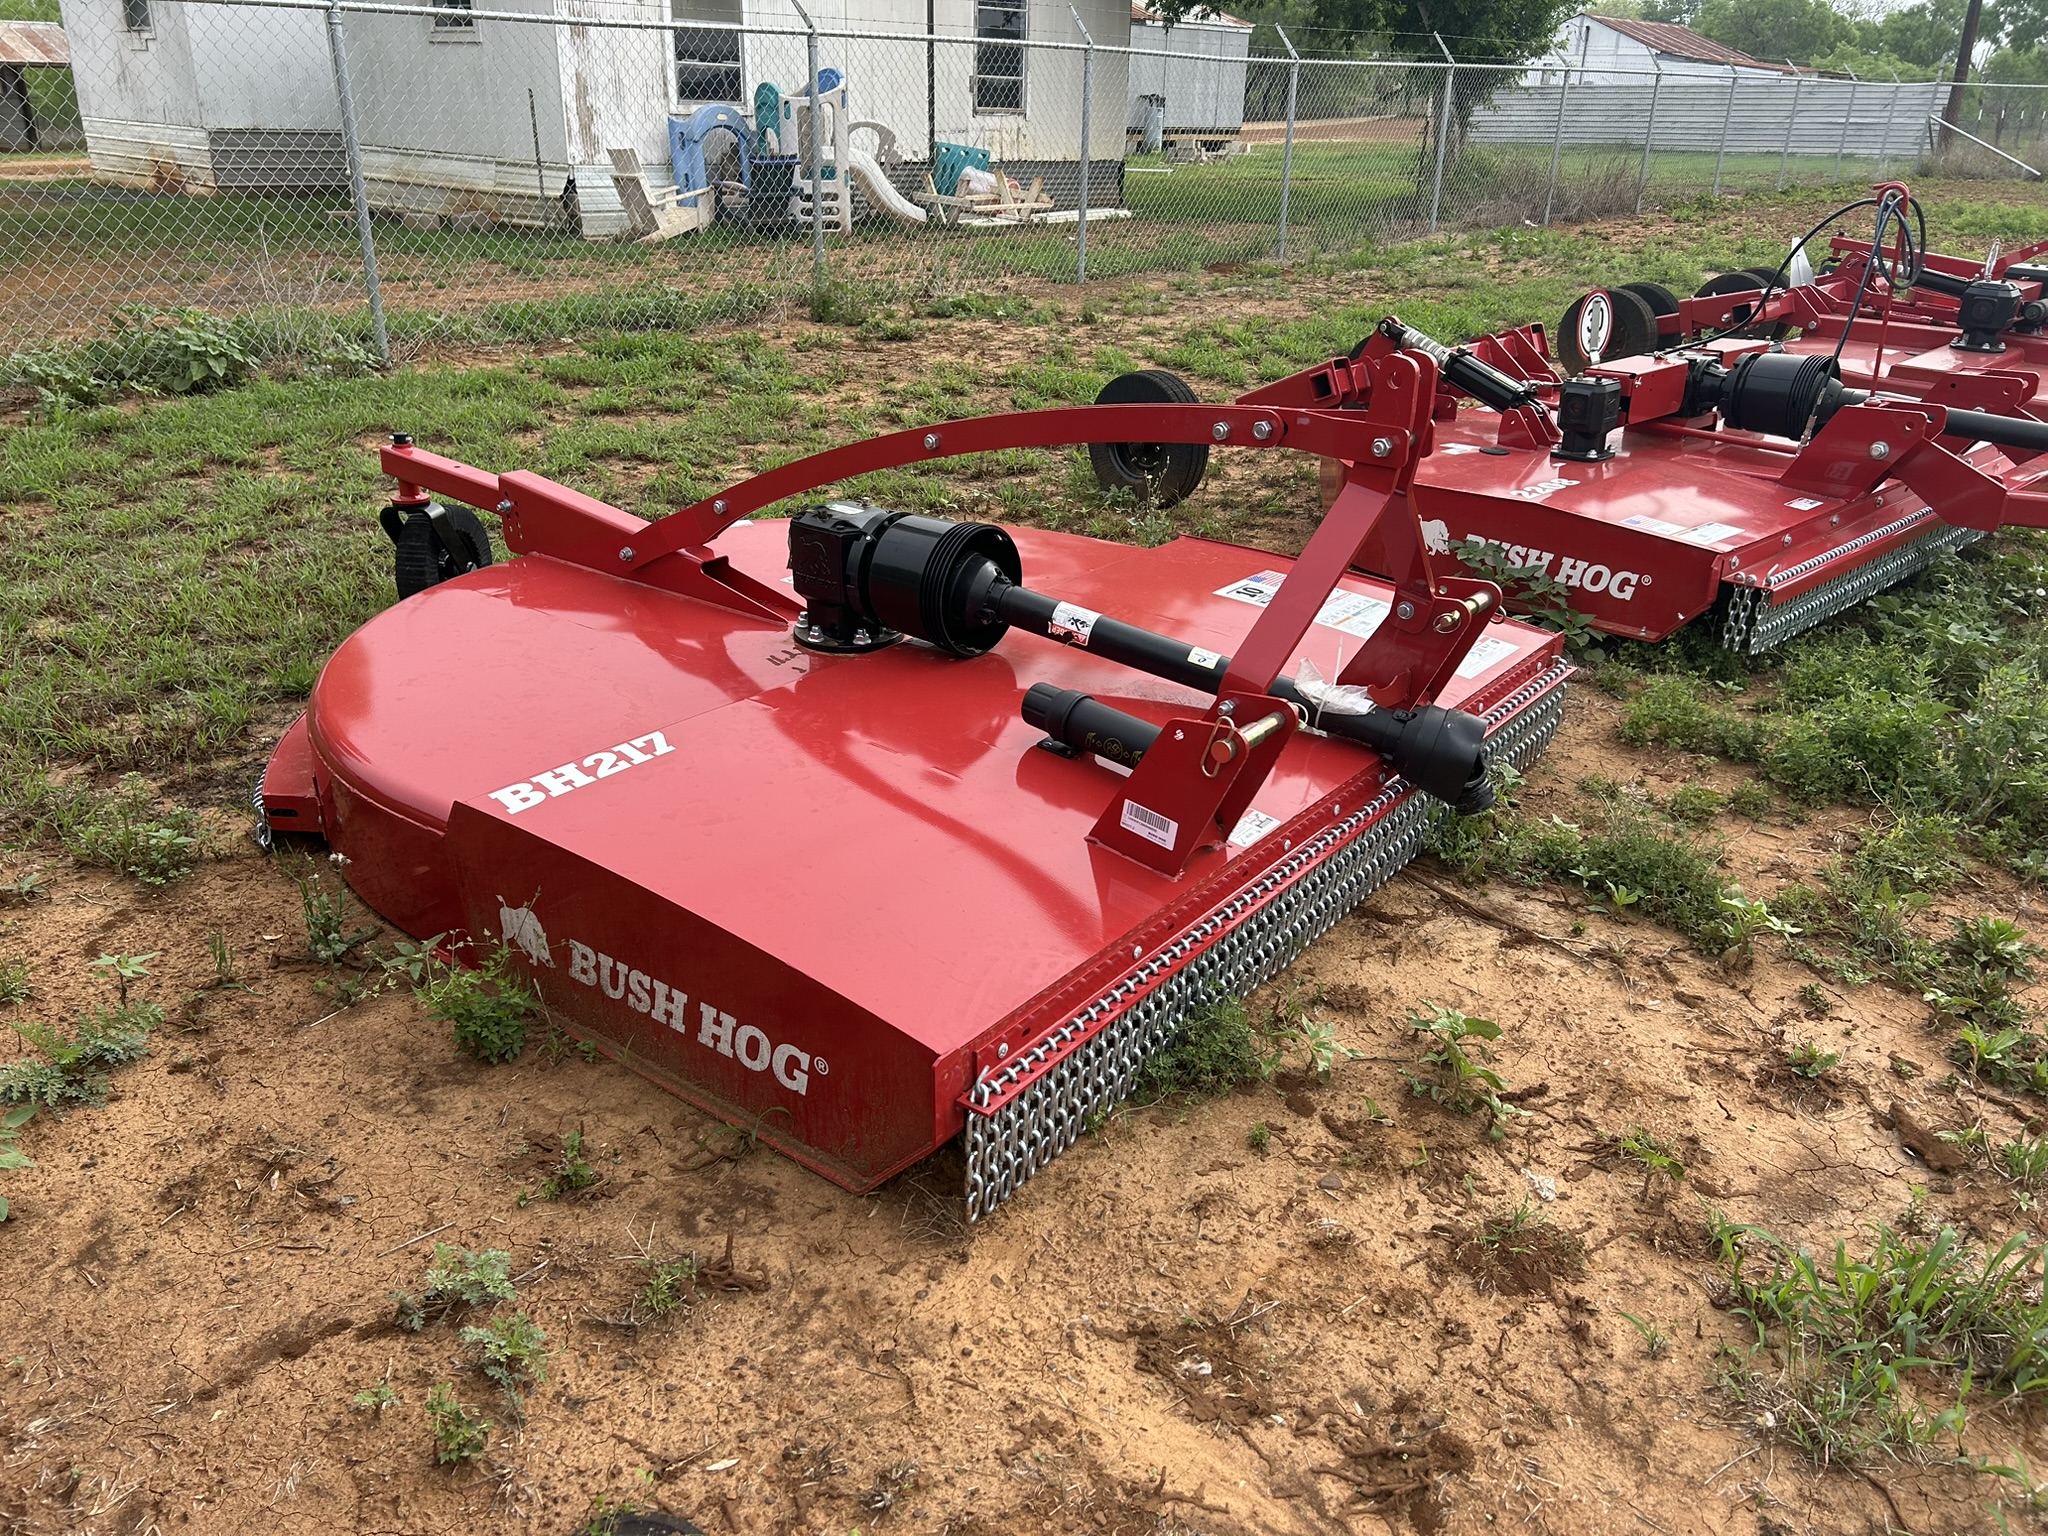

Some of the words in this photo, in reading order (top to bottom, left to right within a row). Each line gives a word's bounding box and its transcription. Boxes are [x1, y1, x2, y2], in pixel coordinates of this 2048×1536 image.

[1508, 478, 1581, 499] 2208
[487, 730, 678, 816] BH217
[568, 938, 688, 1034] BUSH
